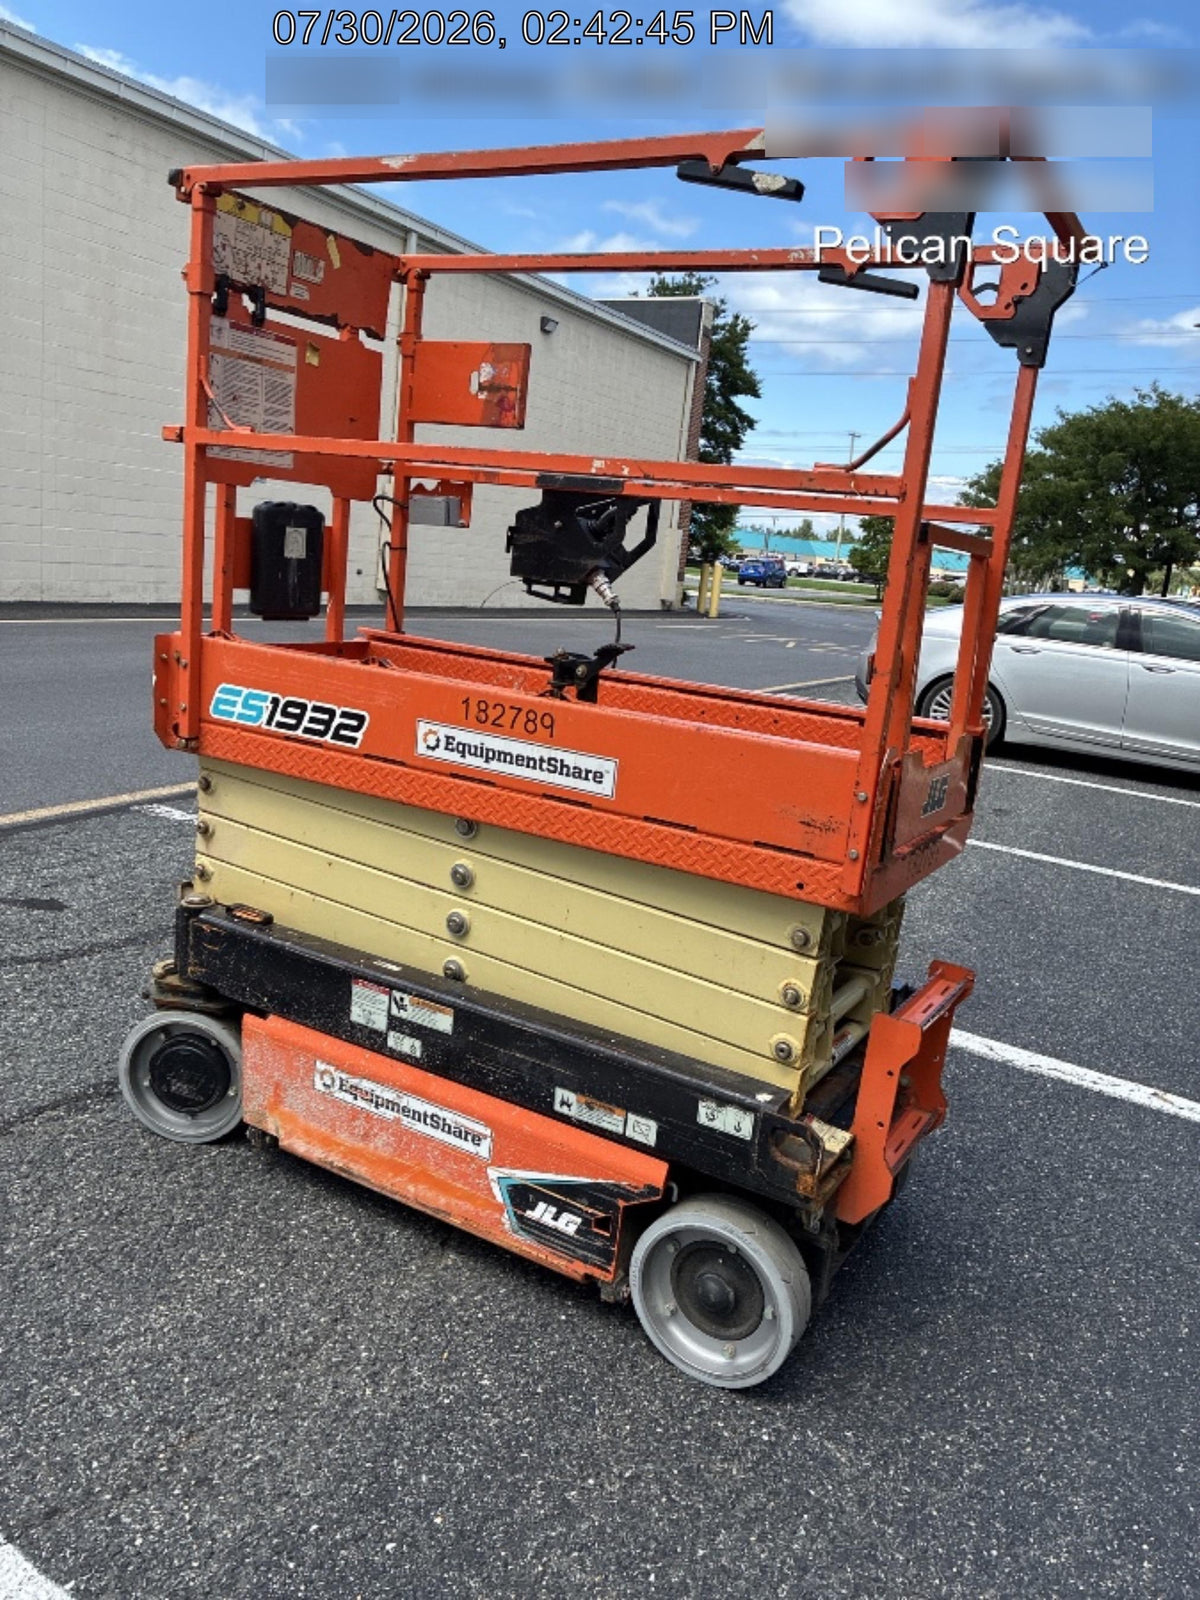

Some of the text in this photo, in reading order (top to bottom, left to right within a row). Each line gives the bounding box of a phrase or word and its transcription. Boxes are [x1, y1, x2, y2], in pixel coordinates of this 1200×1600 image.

[210, 684, 369, 748] ES1932
[461, 697, 556, 739] 182789
[443, 734, 605, 785] EquipmentShare
[338, 1075, 483, 1147] EquipmentShare
[525, 1201, 582, 1236] JLG
